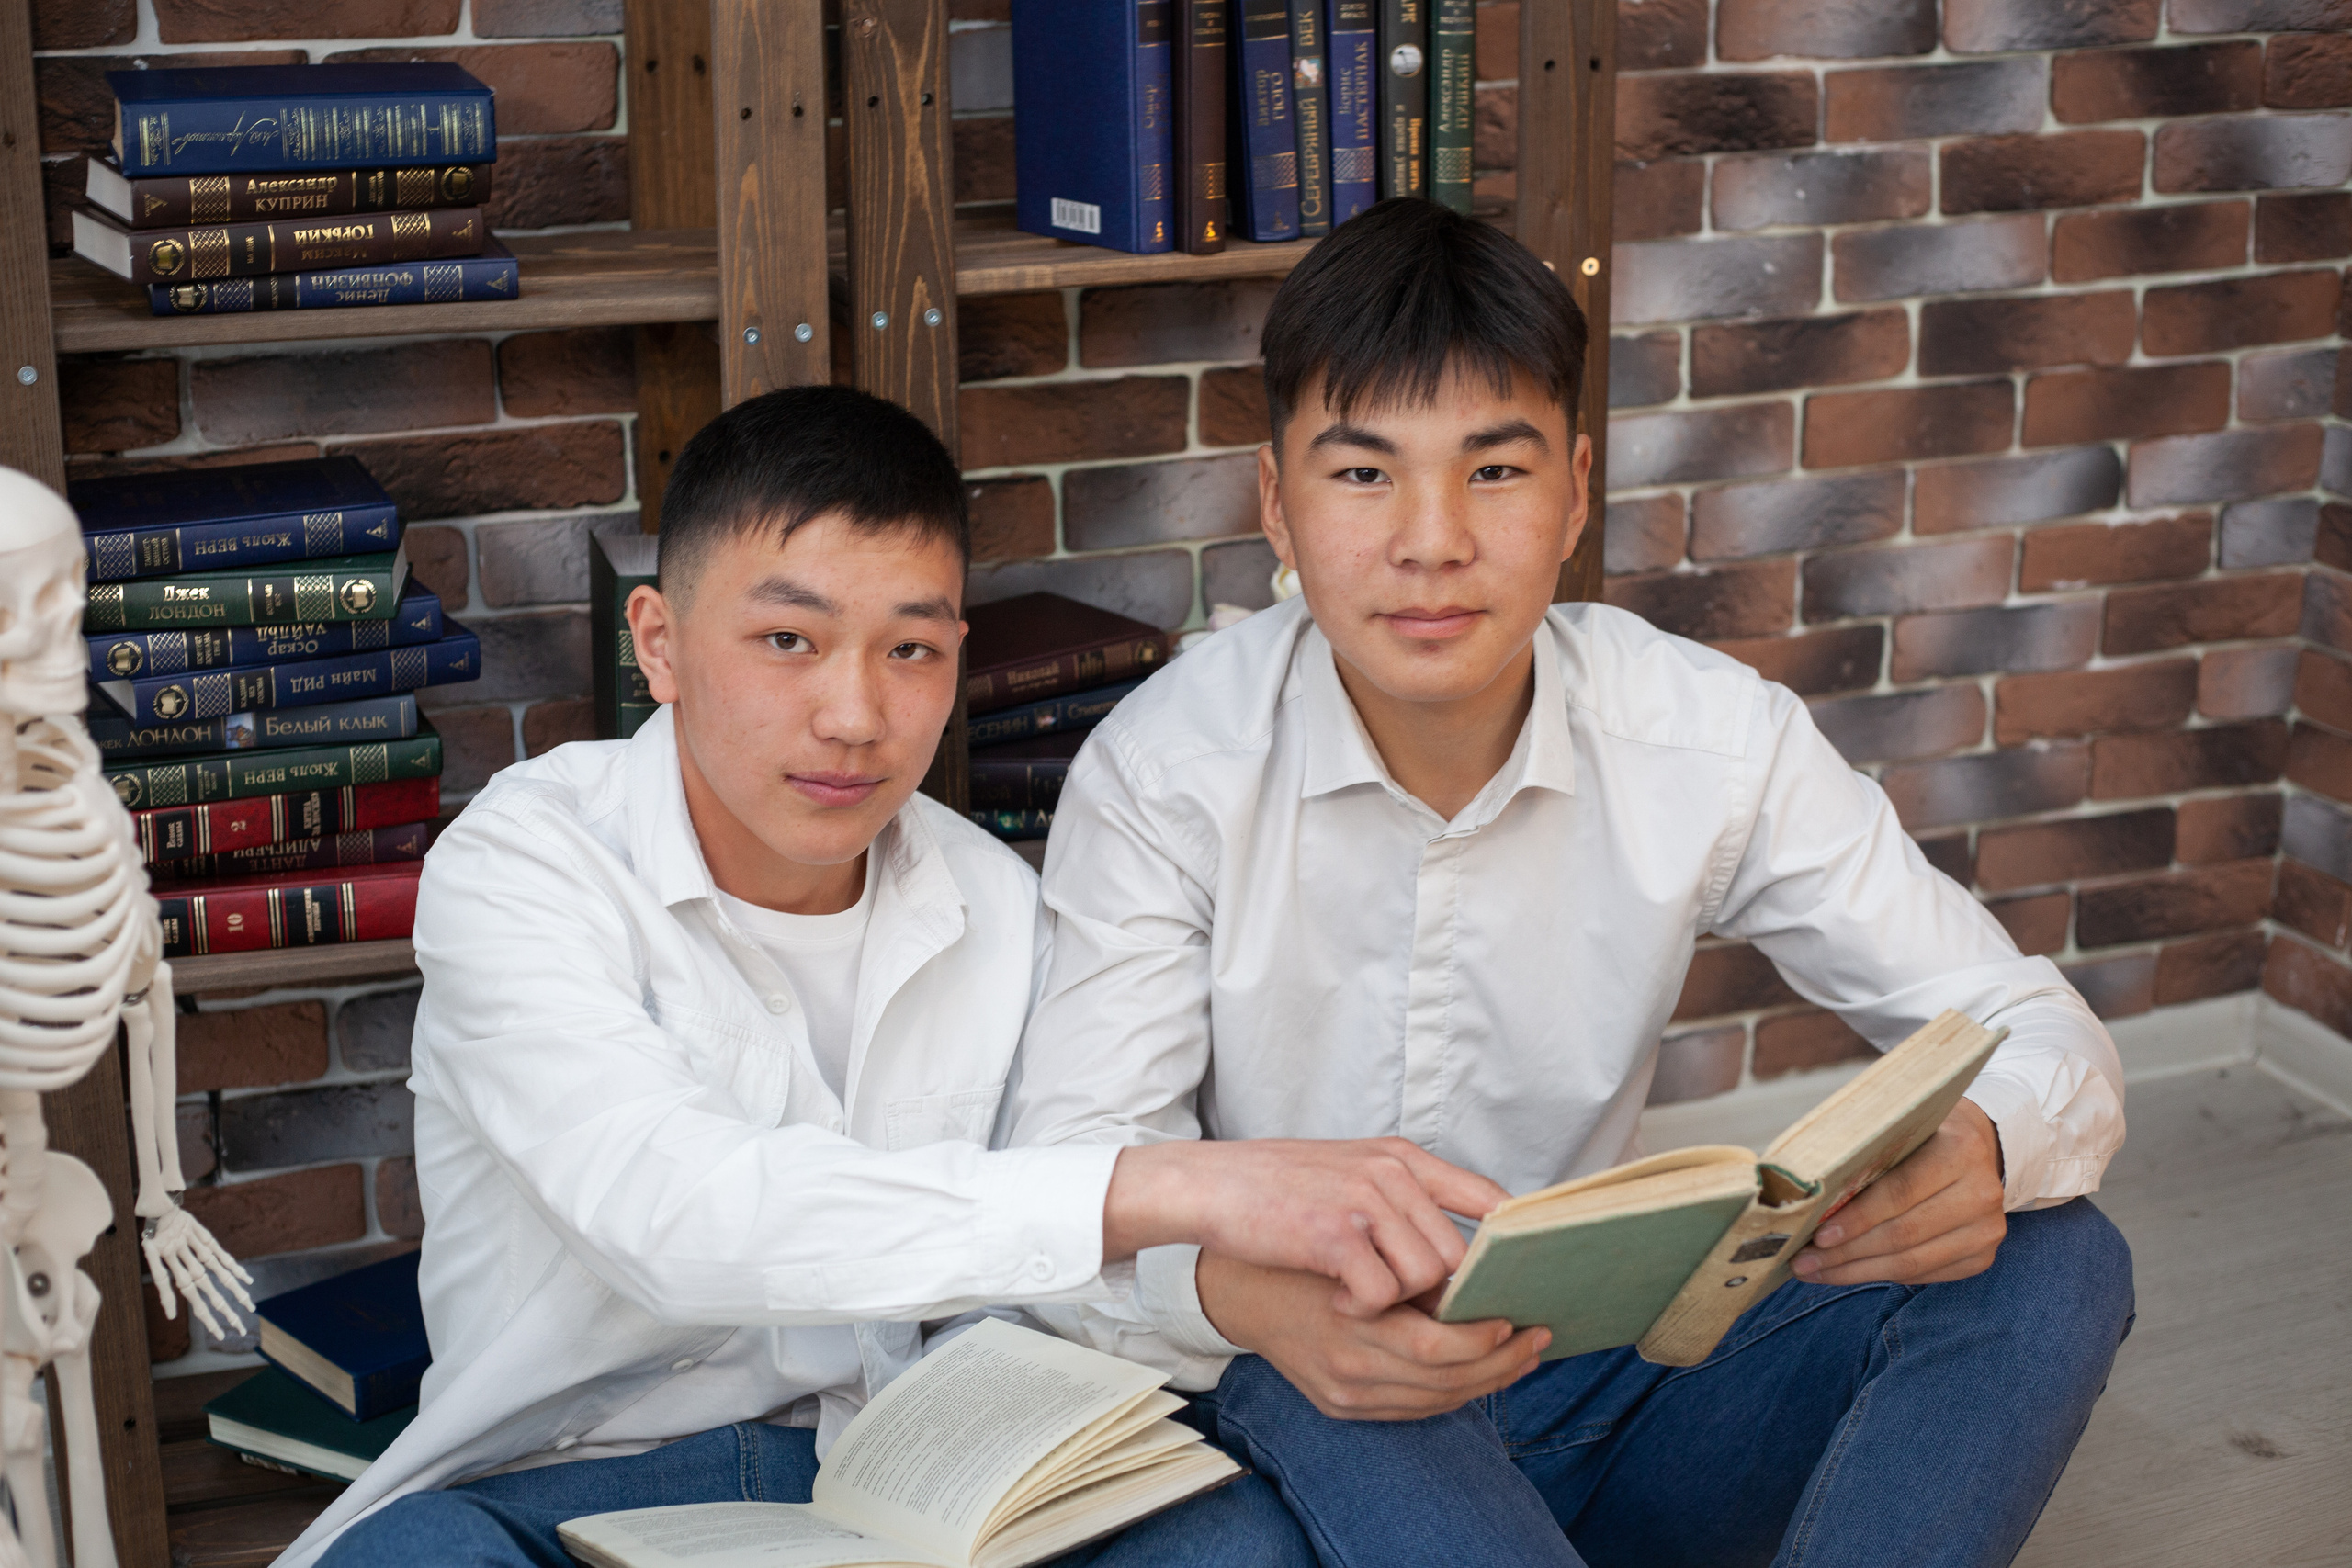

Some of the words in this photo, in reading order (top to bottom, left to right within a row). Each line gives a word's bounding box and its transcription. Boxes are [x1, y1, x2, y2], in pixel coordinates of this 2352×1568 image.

[1255, 69, 1270, 127] Виктор
[1271, 71, 1284, 121] ГЮГО
[1338, 67, 1354, 114] Борис
[1354, 41, 1370, 140] ПАСТЕРНАК
[1437, 48, 1455, 133] Александр
[1455, 53, 1470, 129] ПУШКИН
[244, 175, 338, 196] Александр
[254, 194, 329, 214] КУПРИН
[293, 223, 375, 245] ГОРЬКИЙ
[301, 245, 368, 262] Максим
[311, 272, 413, 291] ФОНВИЗИН
[335, 288, 390, 304] Денис
[194, 536, 237, 557] ВЕРН
[241, 532, 293, 550] Жюль
[163, 584, 210, 603] Джек
[148, 604, 226, 622] ЛОНДОН
[267, 639, 320, 657] Оскар
[289, 675, 325, 694] РИД
[330, 666, 377, 684] Майн
[266, 716, 332, 737] Белый
[338, 714, 388, 732] клык
[127, 726, 213, 748] ЛОНДОН
[243, 767, 286, 785] ВЕРН
[289, 761, 339, 780] Жюль
[231, 819, 247, 833] 2
[249, 853, 306, 870] ДАНТЕ
[227, 913, 244, 933] 10
